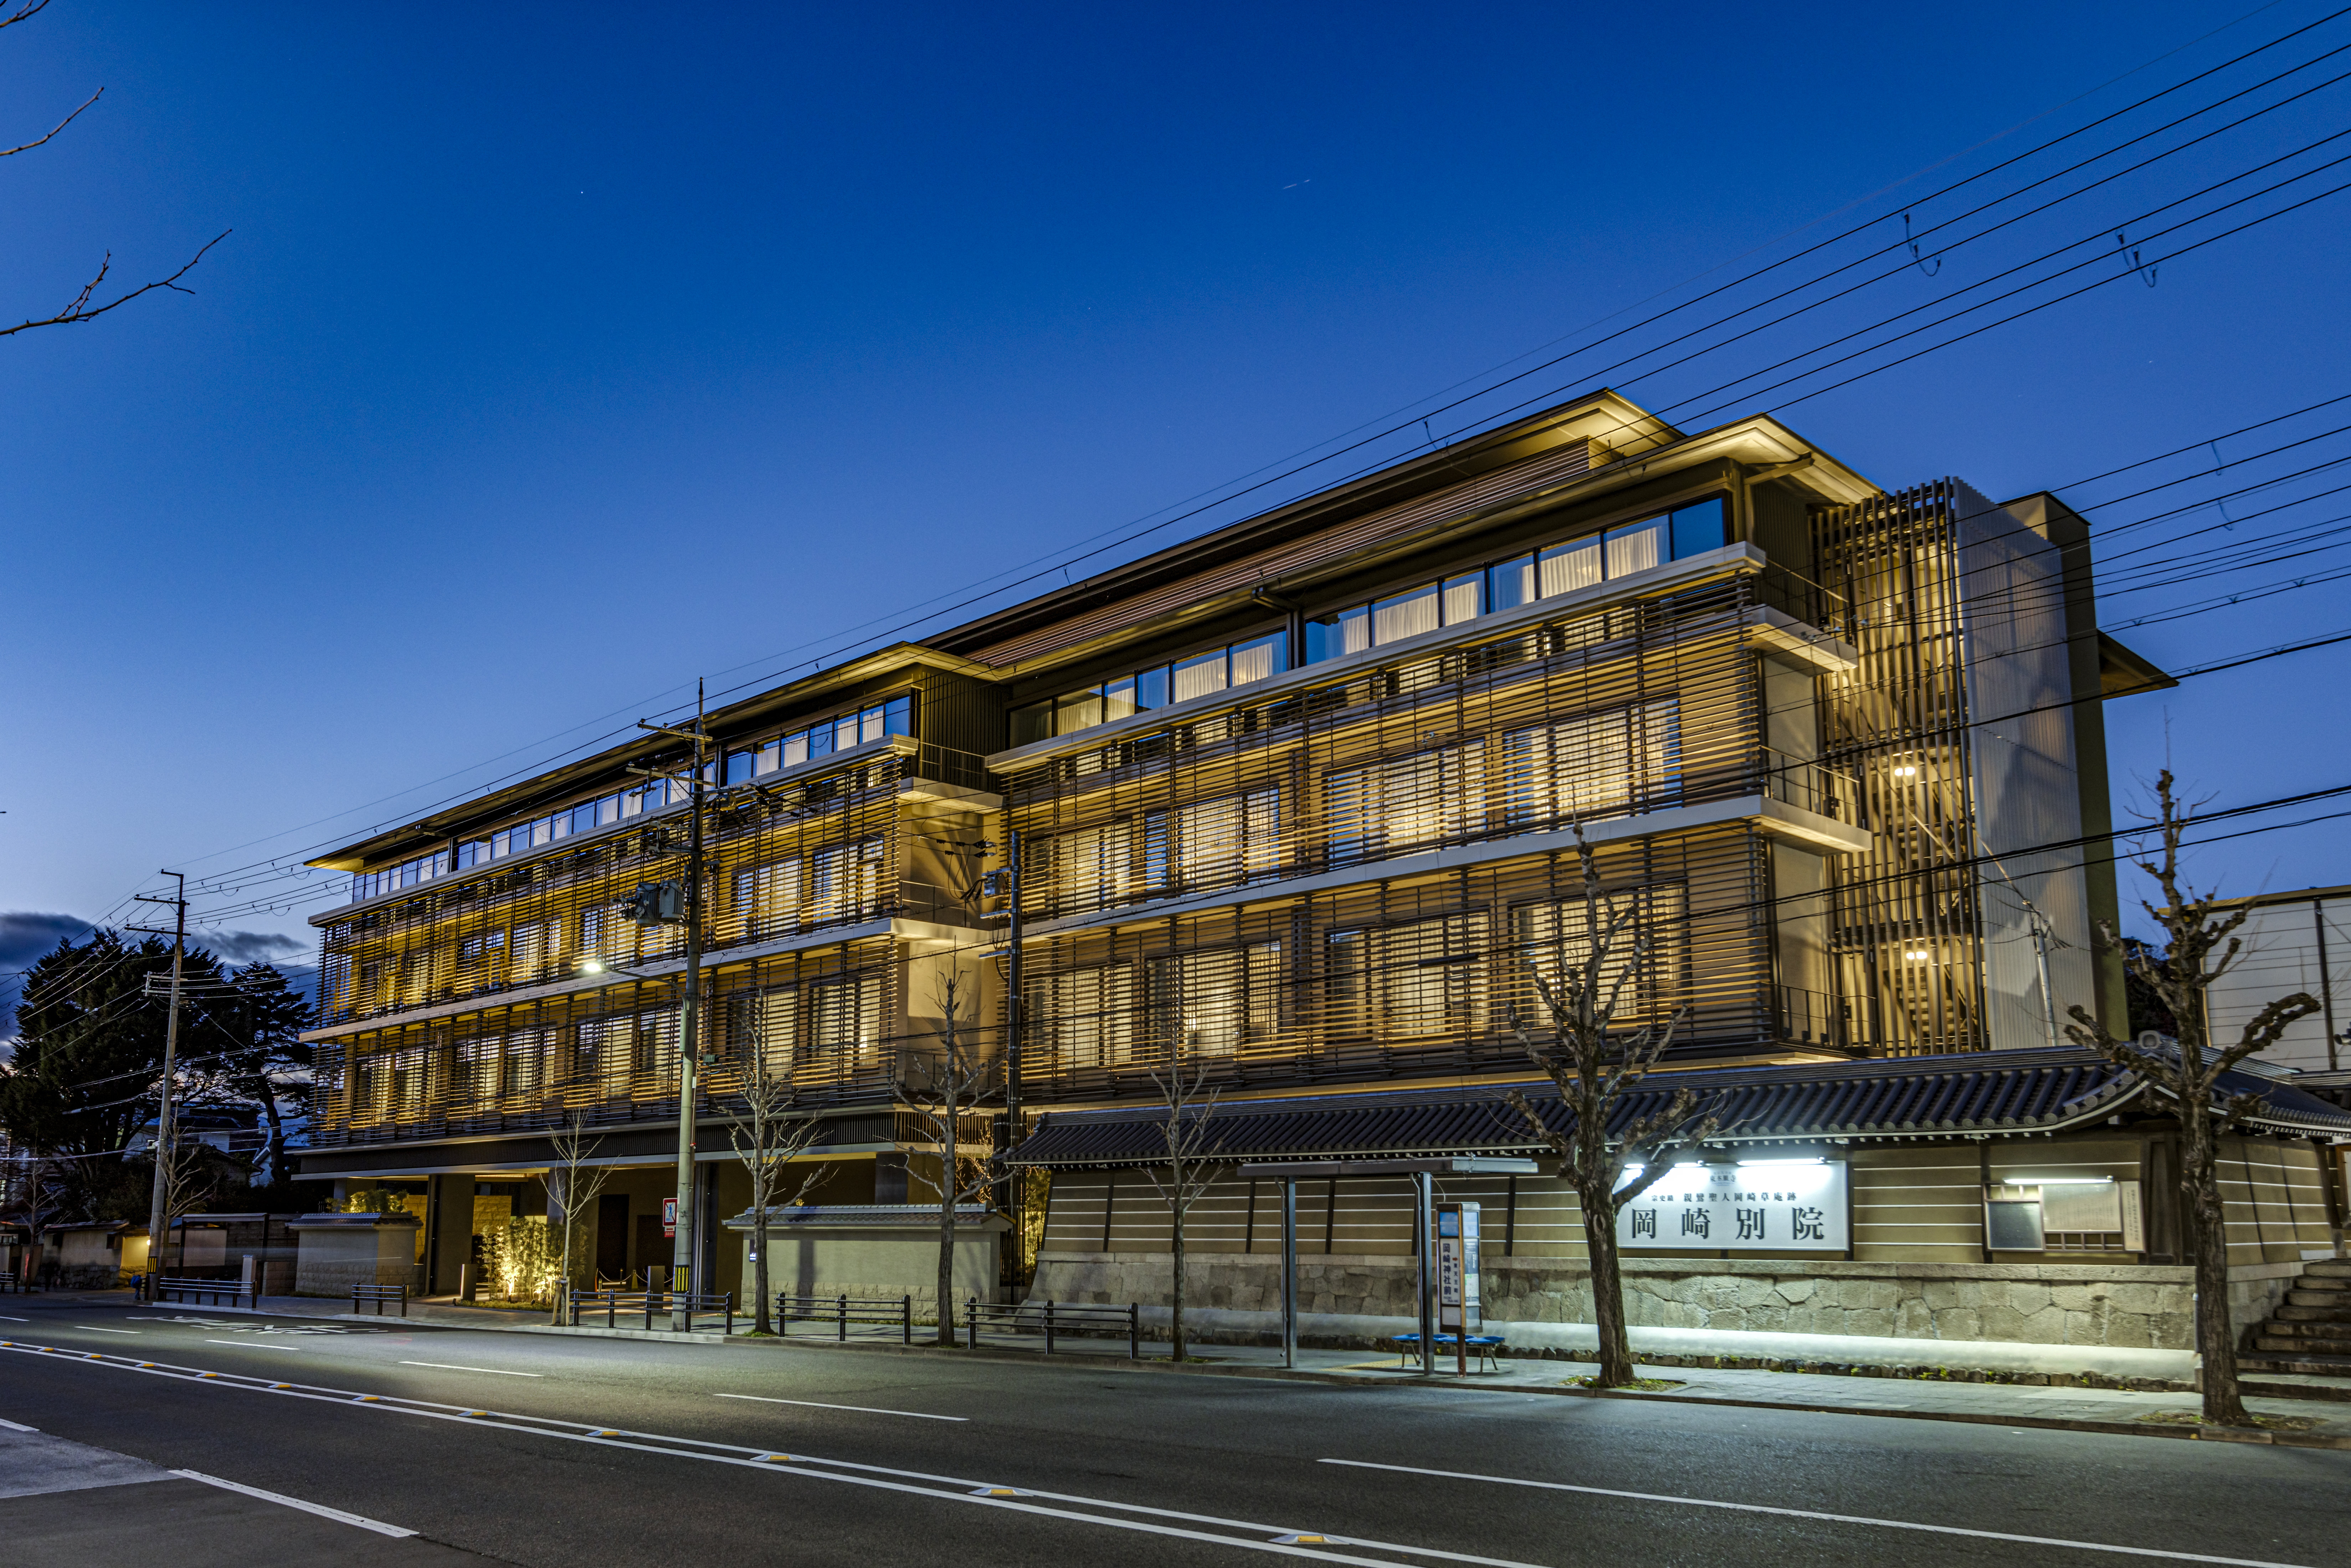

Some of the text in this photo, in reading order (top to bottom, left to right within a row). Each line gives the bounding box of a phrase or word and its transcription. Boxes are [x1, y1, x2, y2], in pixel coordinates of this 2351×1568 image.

[1684, 1192, 1797, 1202] 親鸞聖人岡崎草庵跡
[1631, 1207, 1824, 1240] 岡崎別院
[1443, 1243, 1451, 1295] 岡崎神社前
